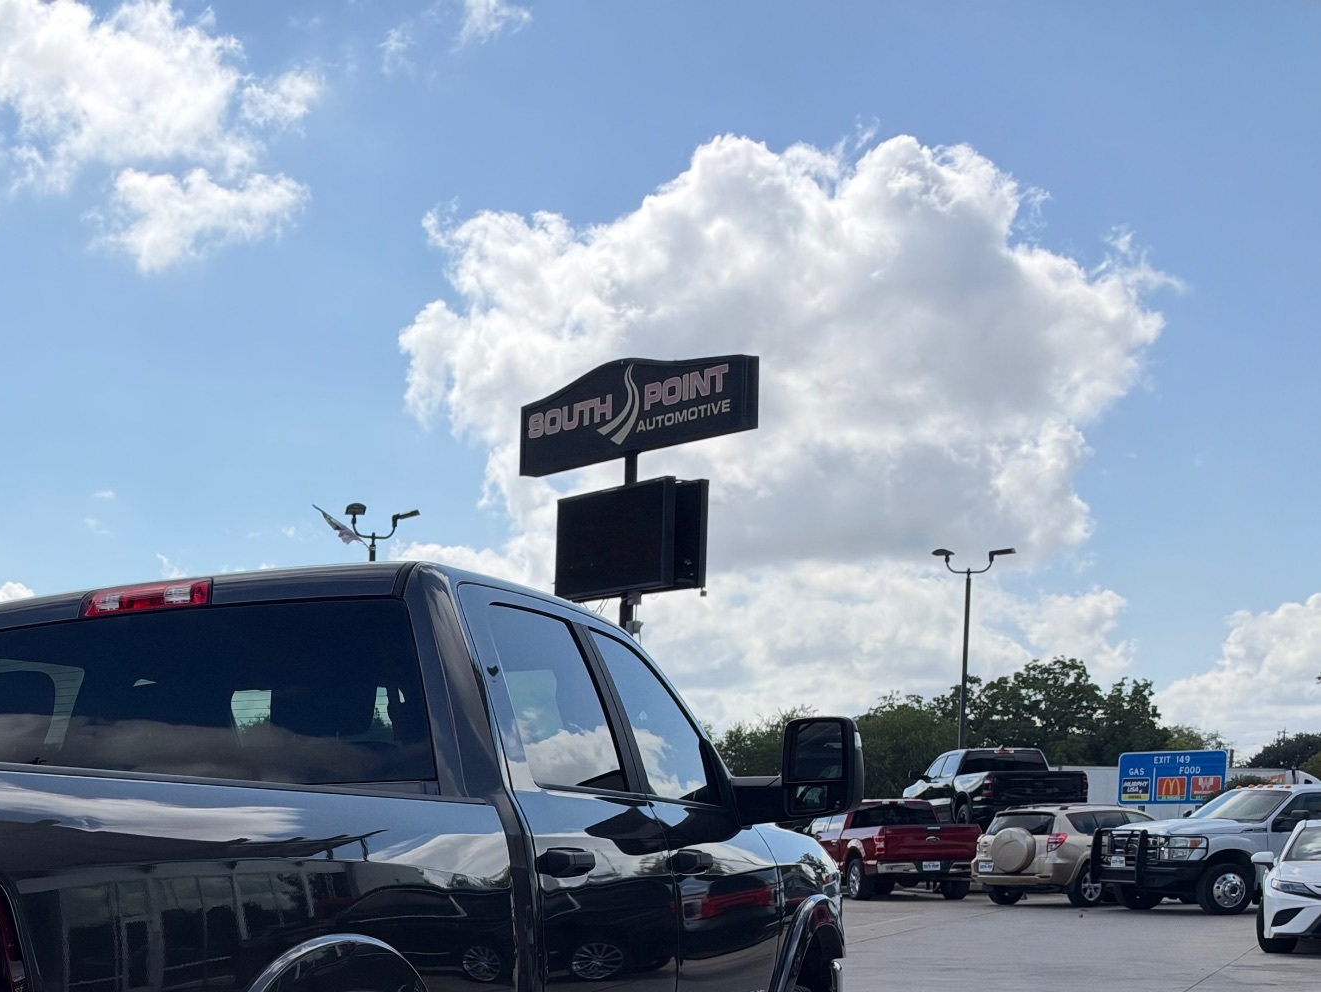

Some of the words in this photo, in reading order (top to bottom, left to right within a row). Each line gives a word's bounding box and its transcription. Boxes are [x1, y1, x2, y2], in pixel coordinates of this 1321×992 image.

[528, 394, 613, 439] SOUTH
[644, 363, 730, 411] POINT
[636, 399, 731, 434] AUTOMOTIVE
[1153, 756, 1171, 764] EXIT
[1176, 755, 1190, 764] 149
[1128, 767, 1145, 776] GAS
[1179, 766, 1201, 775] FOOD
